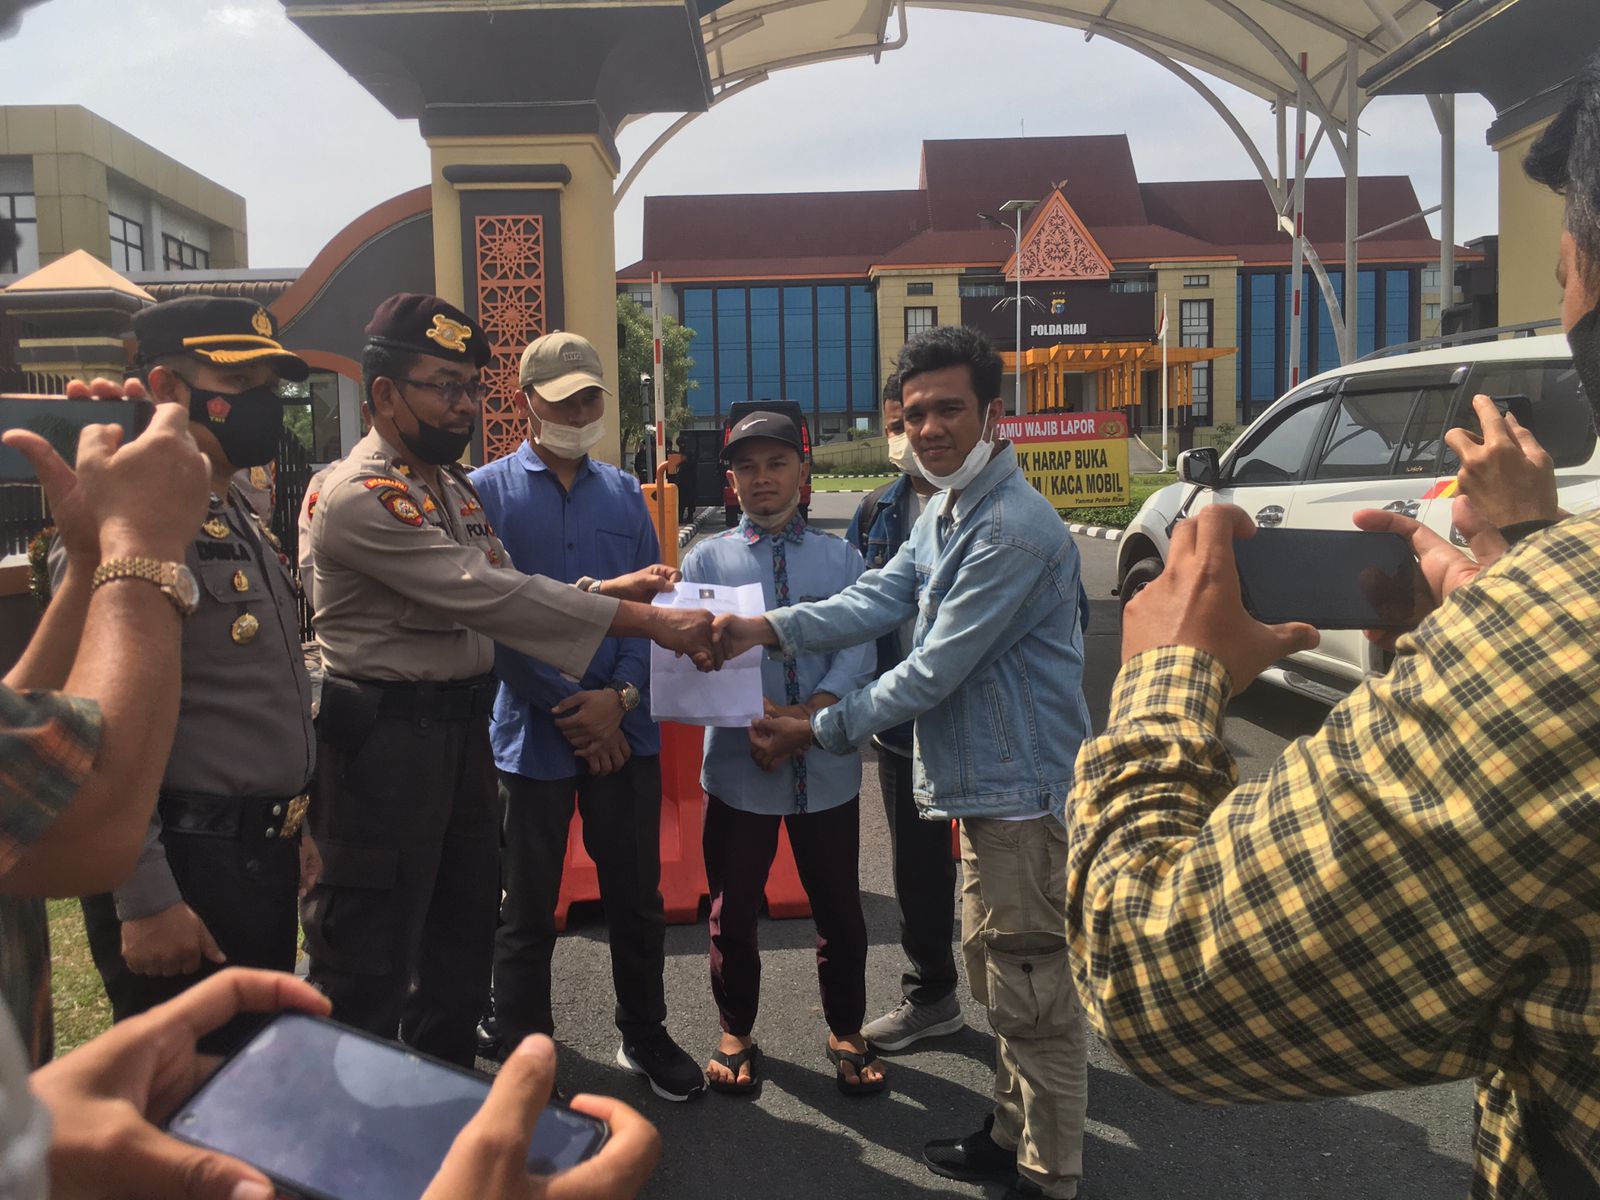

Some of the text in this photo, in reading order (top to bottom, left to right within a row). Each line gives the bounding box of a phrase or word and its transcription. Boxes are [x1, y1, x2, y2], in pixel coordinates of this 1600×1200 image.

[1030, 324, 1087, 336] POLDA RIAU
[1025, 421, 1058, 437] WAJIB
[1061, 419, 1095, 435] LAPOR
[1033, 450, 1071, 471] HARAP
[1075, 448, 1108, 469] BUKA
[1052, 474, 1083, 495] KACA
[1086, 473, 1123, 494] MOBIL
